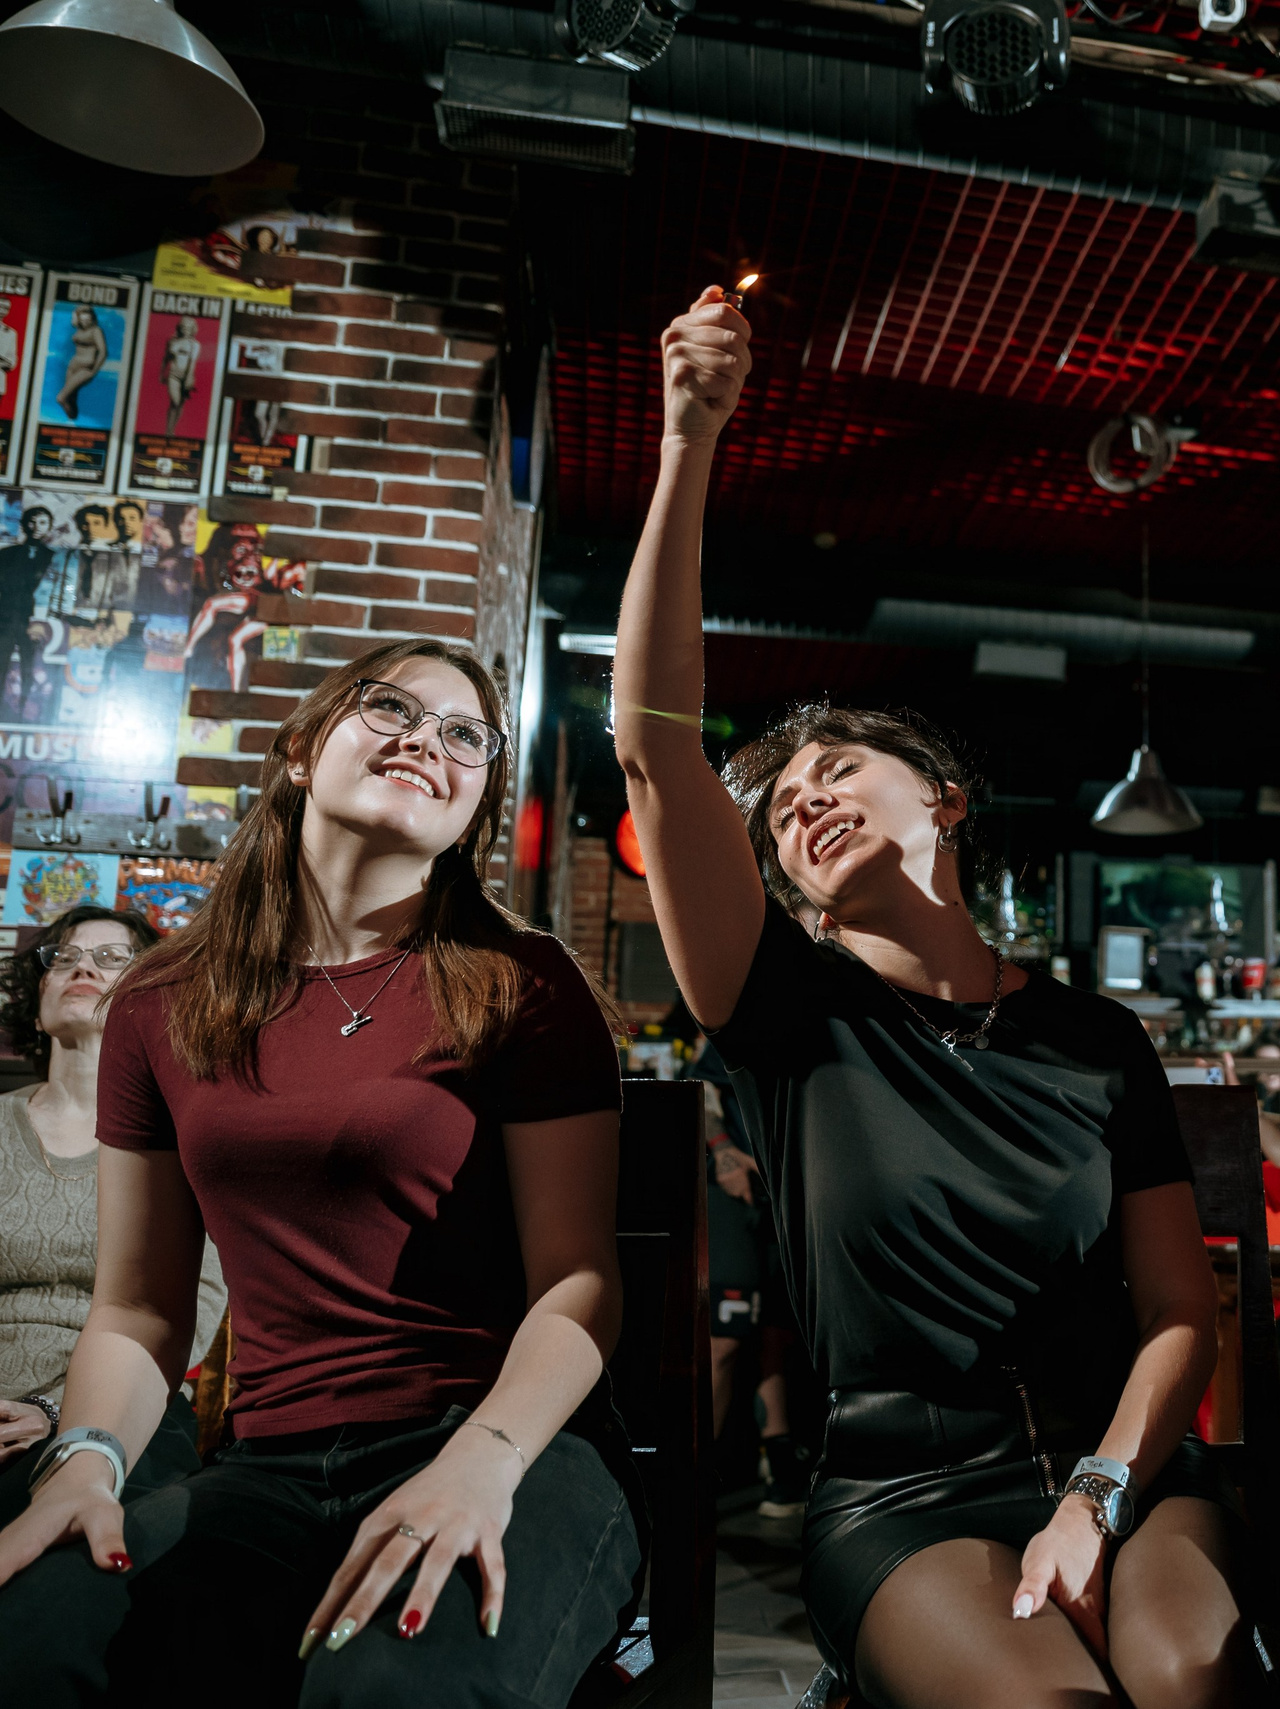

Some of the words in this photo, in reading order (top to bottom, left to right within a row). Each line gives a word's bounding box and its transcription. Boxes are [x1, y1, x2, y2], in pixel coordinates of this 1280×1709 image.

[67, 282, 119, 306] BOND
[152, 293, 200, 316] BACK
[202, 296, 222, 318] IN
